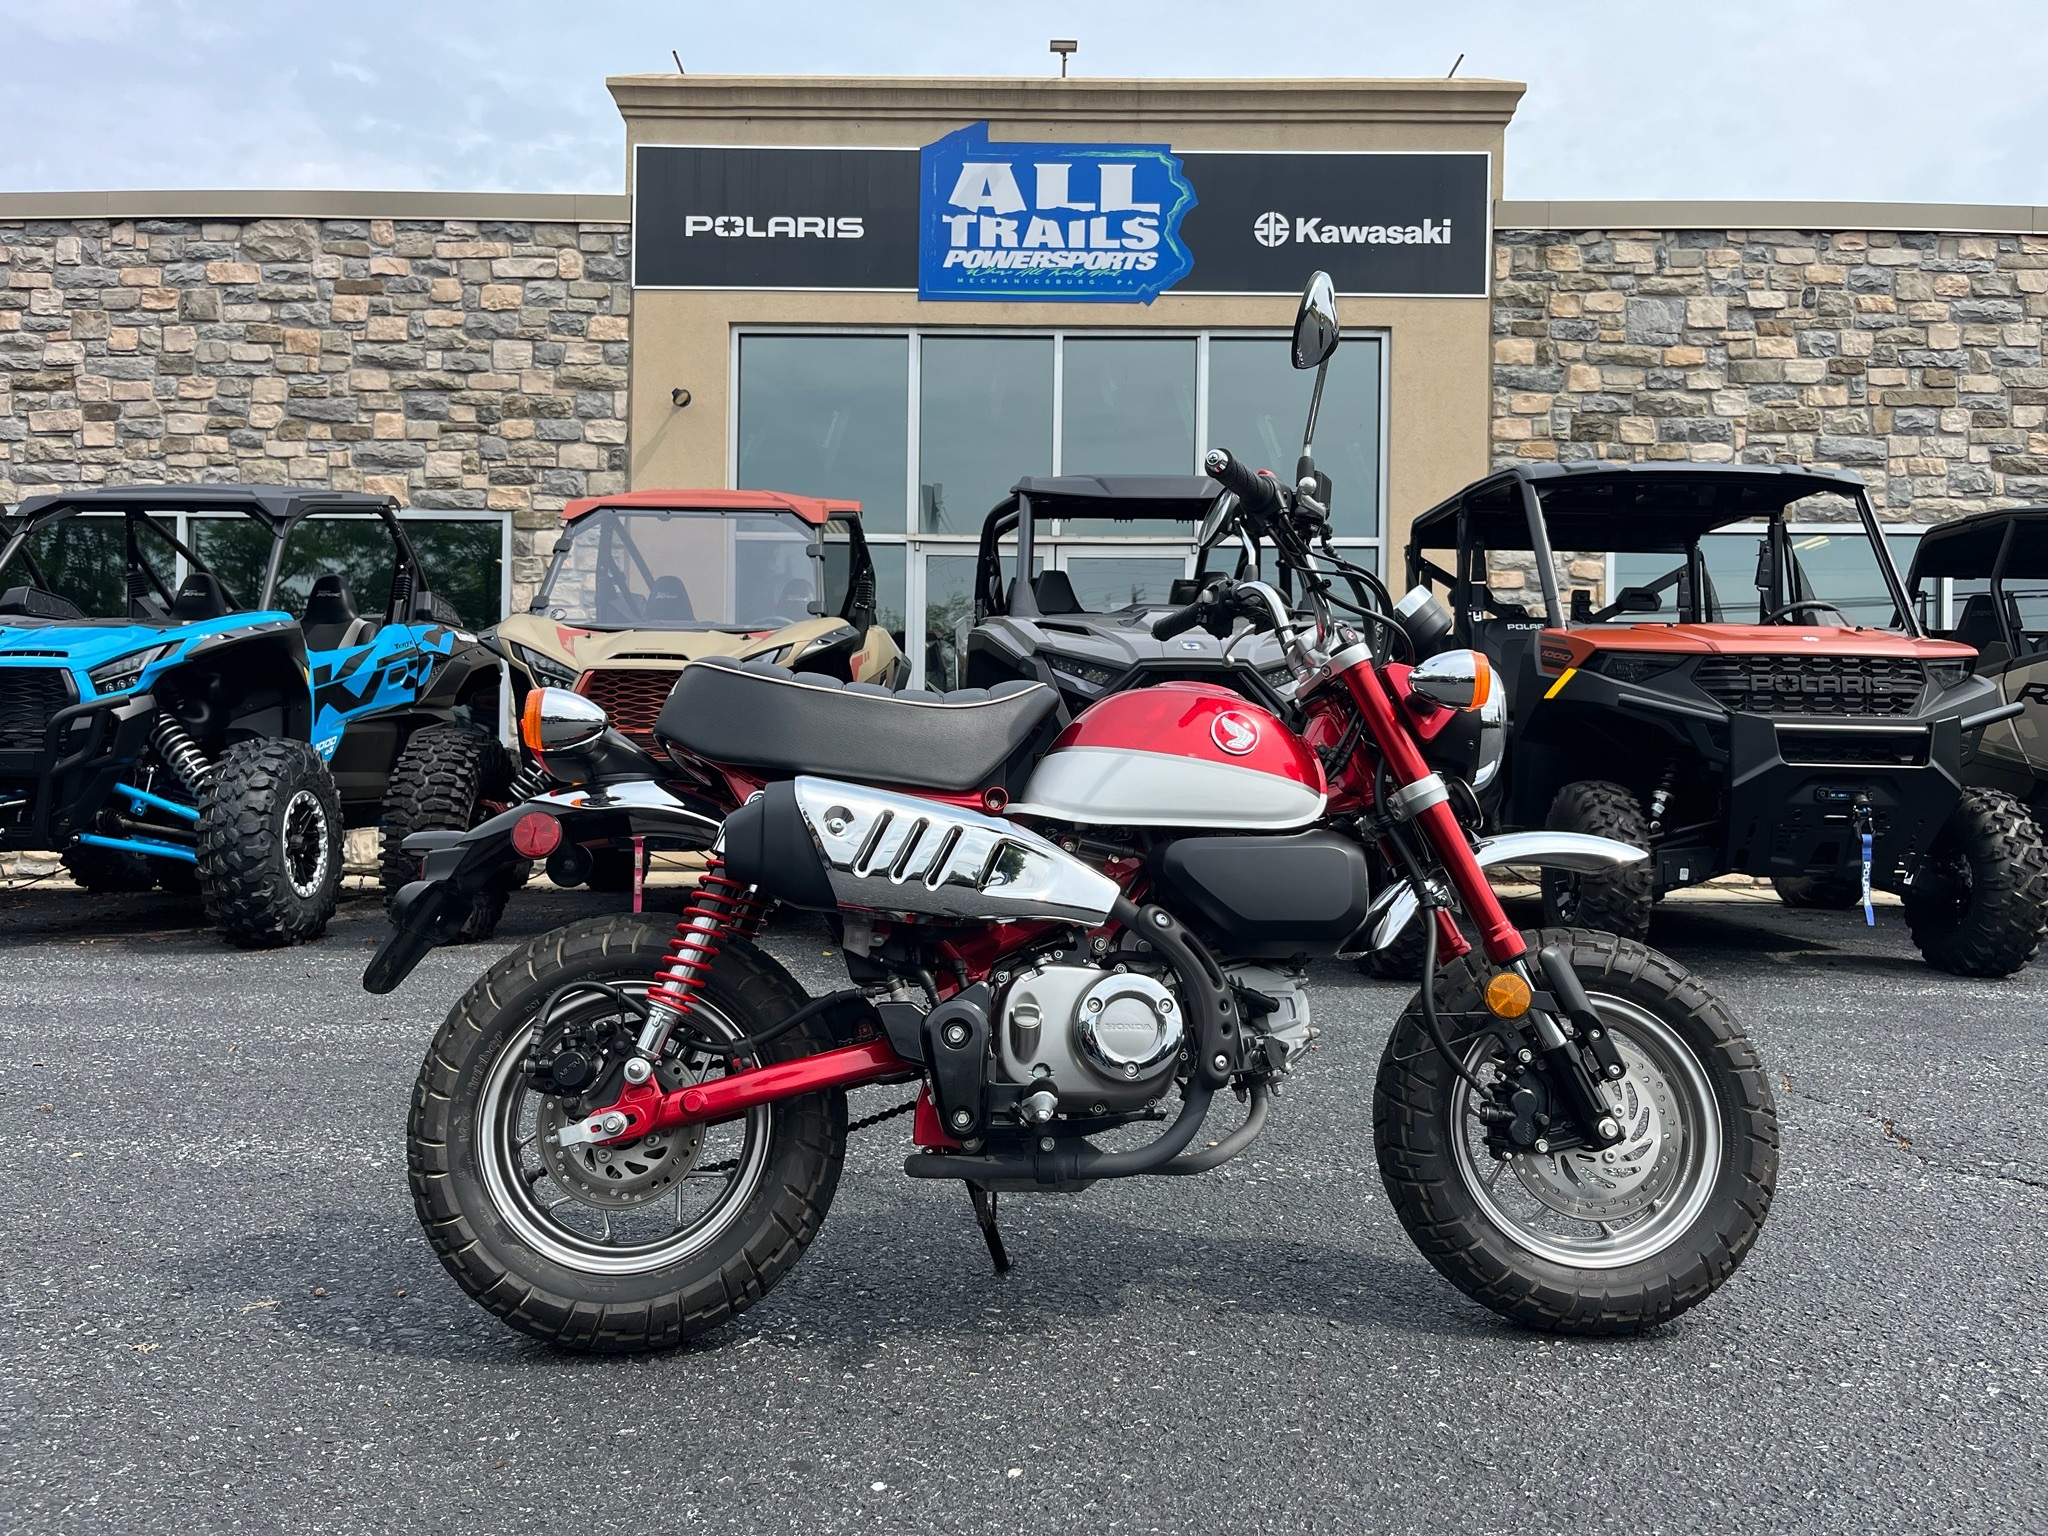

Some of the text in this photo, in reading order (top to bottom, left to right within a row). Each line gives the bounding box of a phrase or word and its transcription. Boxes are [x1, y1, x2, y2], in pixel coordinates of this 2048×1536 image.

[948, 162, 1161, 216] ALL
[684, 215, 865, 238] POLARIS
[942, 214, 1160, 250] TRAILS
[1295, 217, 1452, 245] Kawasaki
[943, 250, 1159, 271] POWERSPORTS
[1507, 623, 1545, 631] POLAR
[1542, 650, 1572, 661] 1000
[1751, 674, 1893, 694] POLARIS
[315, 735, 338, 752] 1000
[1862, 861, 1871, 907] POLARIS
[1105, 1023, 1153, 1031] HONDA
